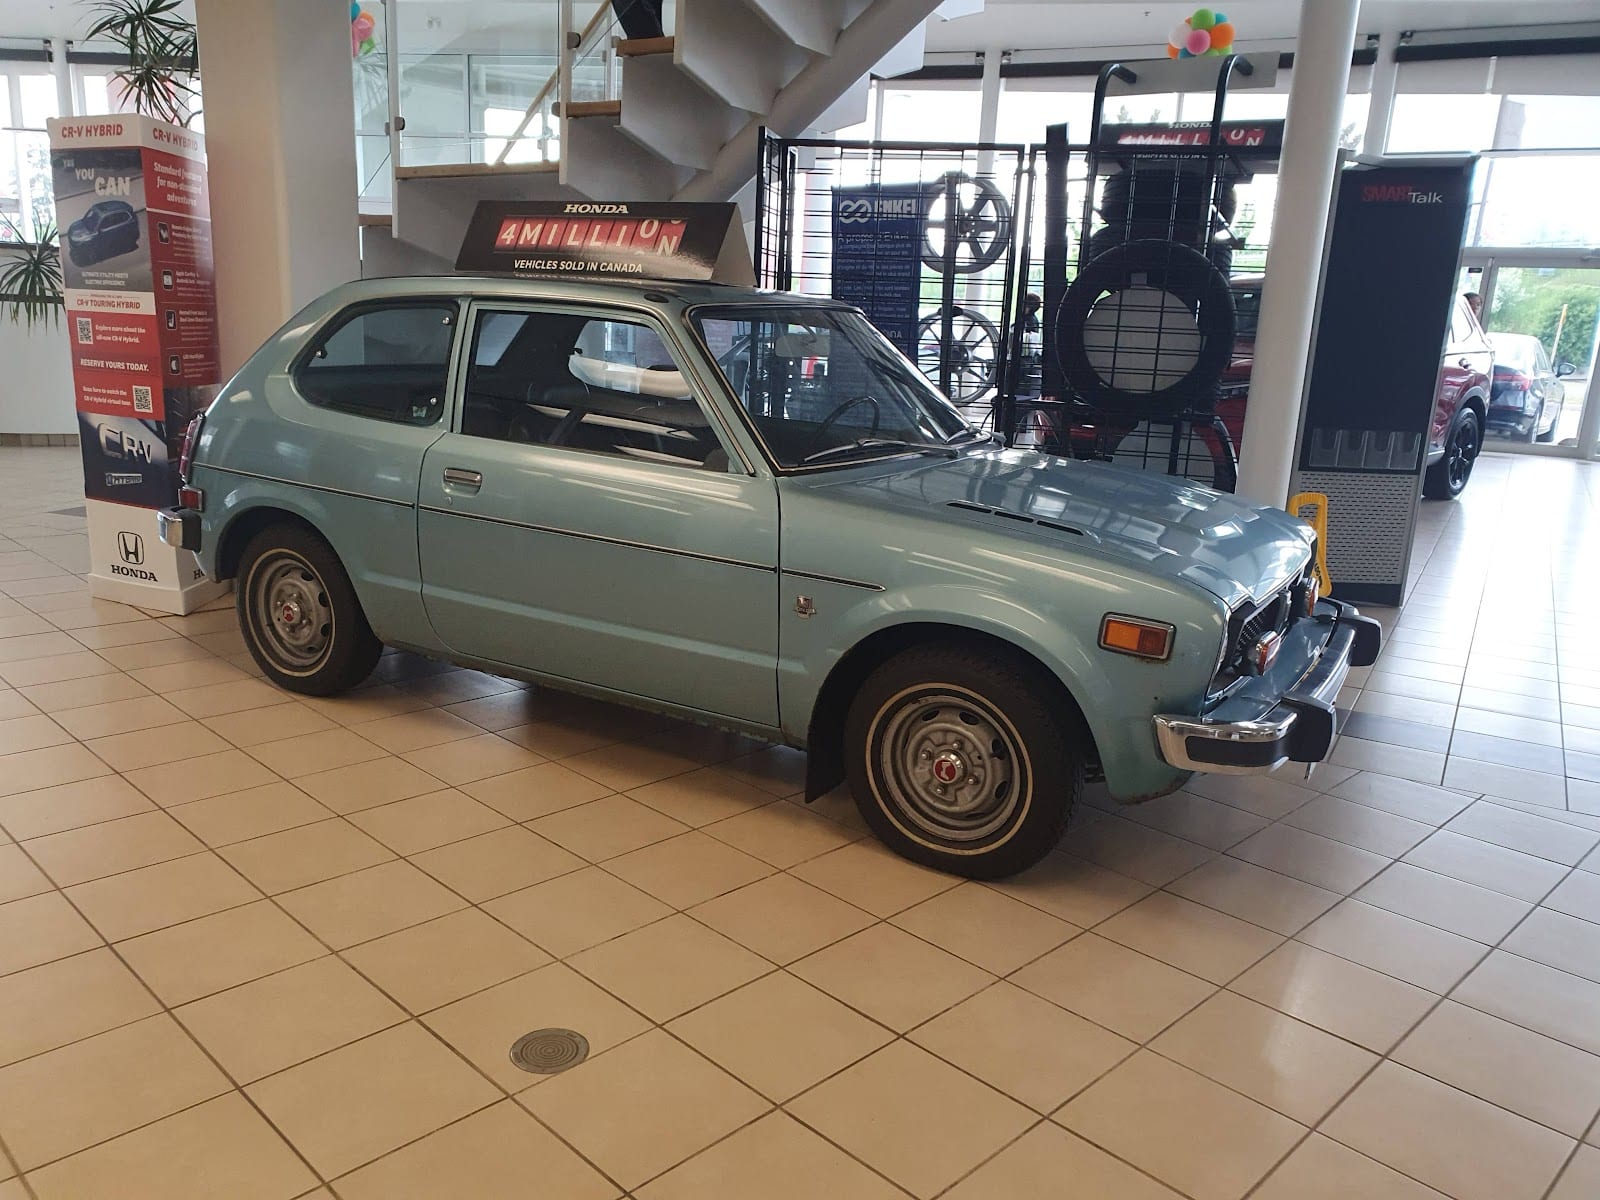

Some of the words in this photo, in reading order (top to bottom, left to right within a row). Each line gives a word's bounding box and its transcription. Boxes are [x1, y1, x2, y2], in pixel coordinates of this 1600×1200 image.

[61, 125, 84, 139] CR-V
[85, 124, 123, 137] HYBRID
[1168, 121, 1213, 129] HOND
[152, 128, 172, 144] CR-V
[172, 134, 199, 152] HYBRID
[75, 168, 95, 181] YOU
[153, 162, 182, 177] Standard
[94, 176, 131, 196] CAN
[157, 175, 166, 188] for
[1408, 191, 1443, 204] Talk
[563, 204, 629, 214] HONDA
[514, 259, 558, 270] VEHICLES
[560, 260, 585, 271] SOLD
[586, 261, 597, 271] IN
[599, 262, 643, 273] CANADA
[76, 298, 90, 306] CR-V
[90, 299, 116, 309] TOURING
[116, 301, 141, 310] HYBRID
[80, 358, 105, 368] RESERVE
[105, 360, 125, 370] YOURS
[126, 362, 150, 372] TODAY.
[97, 422, 152, 464] CR-V
[110, 564, 158, 582] HONDA
